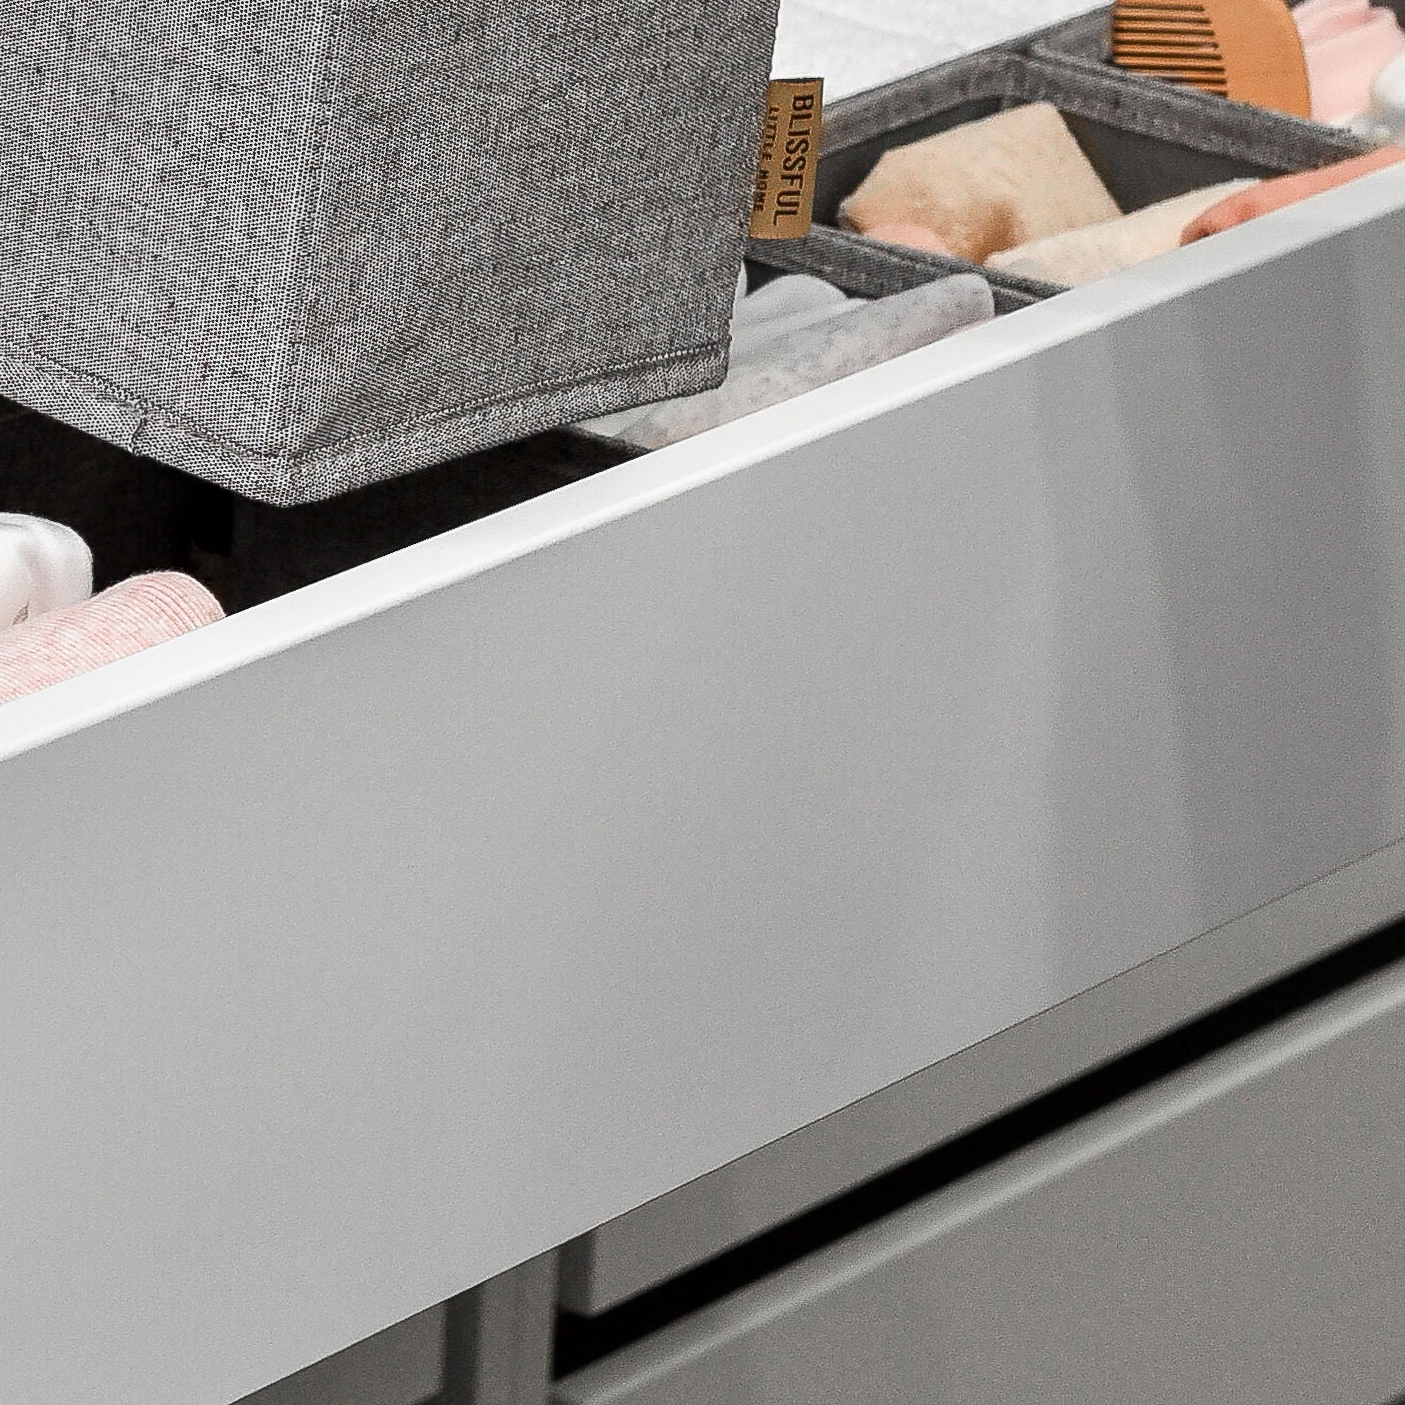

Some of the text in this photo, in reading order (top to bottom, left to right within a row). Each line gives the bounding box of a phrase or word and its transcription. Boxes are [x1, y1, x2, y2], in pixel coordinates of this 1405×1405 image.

[753, 106, 781, 213] LITTLE HOME
[772, 93, 815, 227] BLISSFUL
